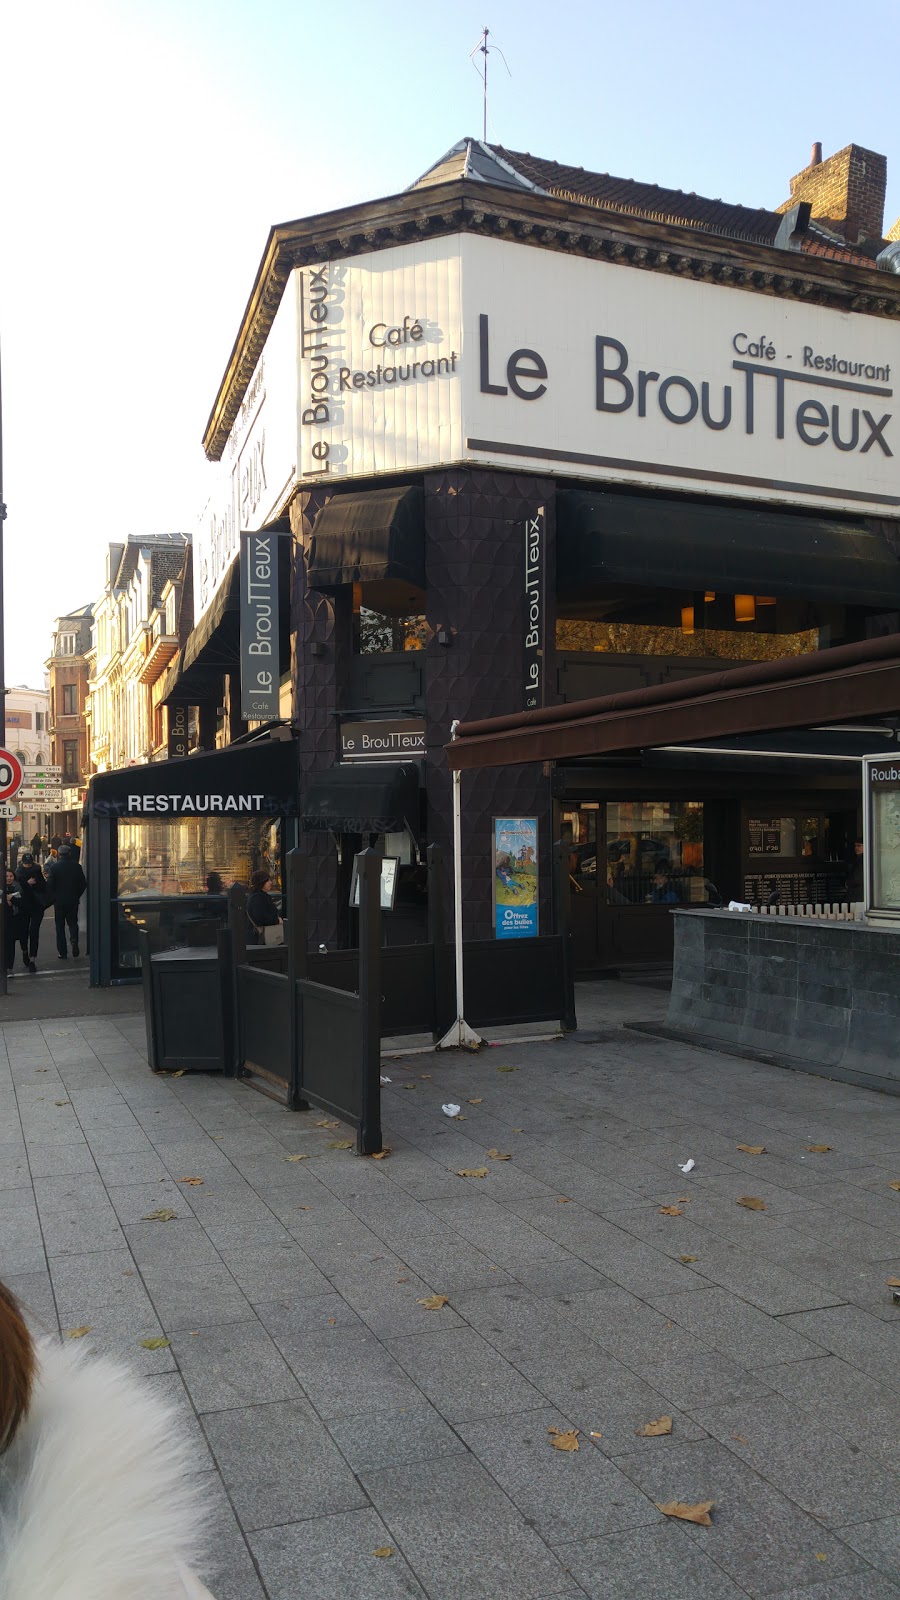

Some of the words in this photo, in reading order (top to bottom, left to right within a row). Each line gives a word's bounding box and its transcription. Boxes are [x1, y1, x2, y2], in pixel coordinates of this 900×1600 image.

[368, 318, 424, 349] Café
[731, 332, 777, 362] Café
[802, 345, 892, 383] Restaurant
[339, 352, 457, 391] Restaurant
[479, 313, 548, 400] Le
[594, 334, 894, 458] BrouTTeux
[302, 440, 329, 478] Le
[247, 670, 273, 695] Le
[524, 663, 540, 690] Le
[243, 712, 279, 720] Restaurant
[251, 701, 269, 710] Café
[172, 743, 185, 757] Le
[342, 735, 355, 750] Le
[0, 808, 13, 816] EL
[127, 794, 265, 812] RESTAURANT
[504, 909, 528, 920] Offrez
